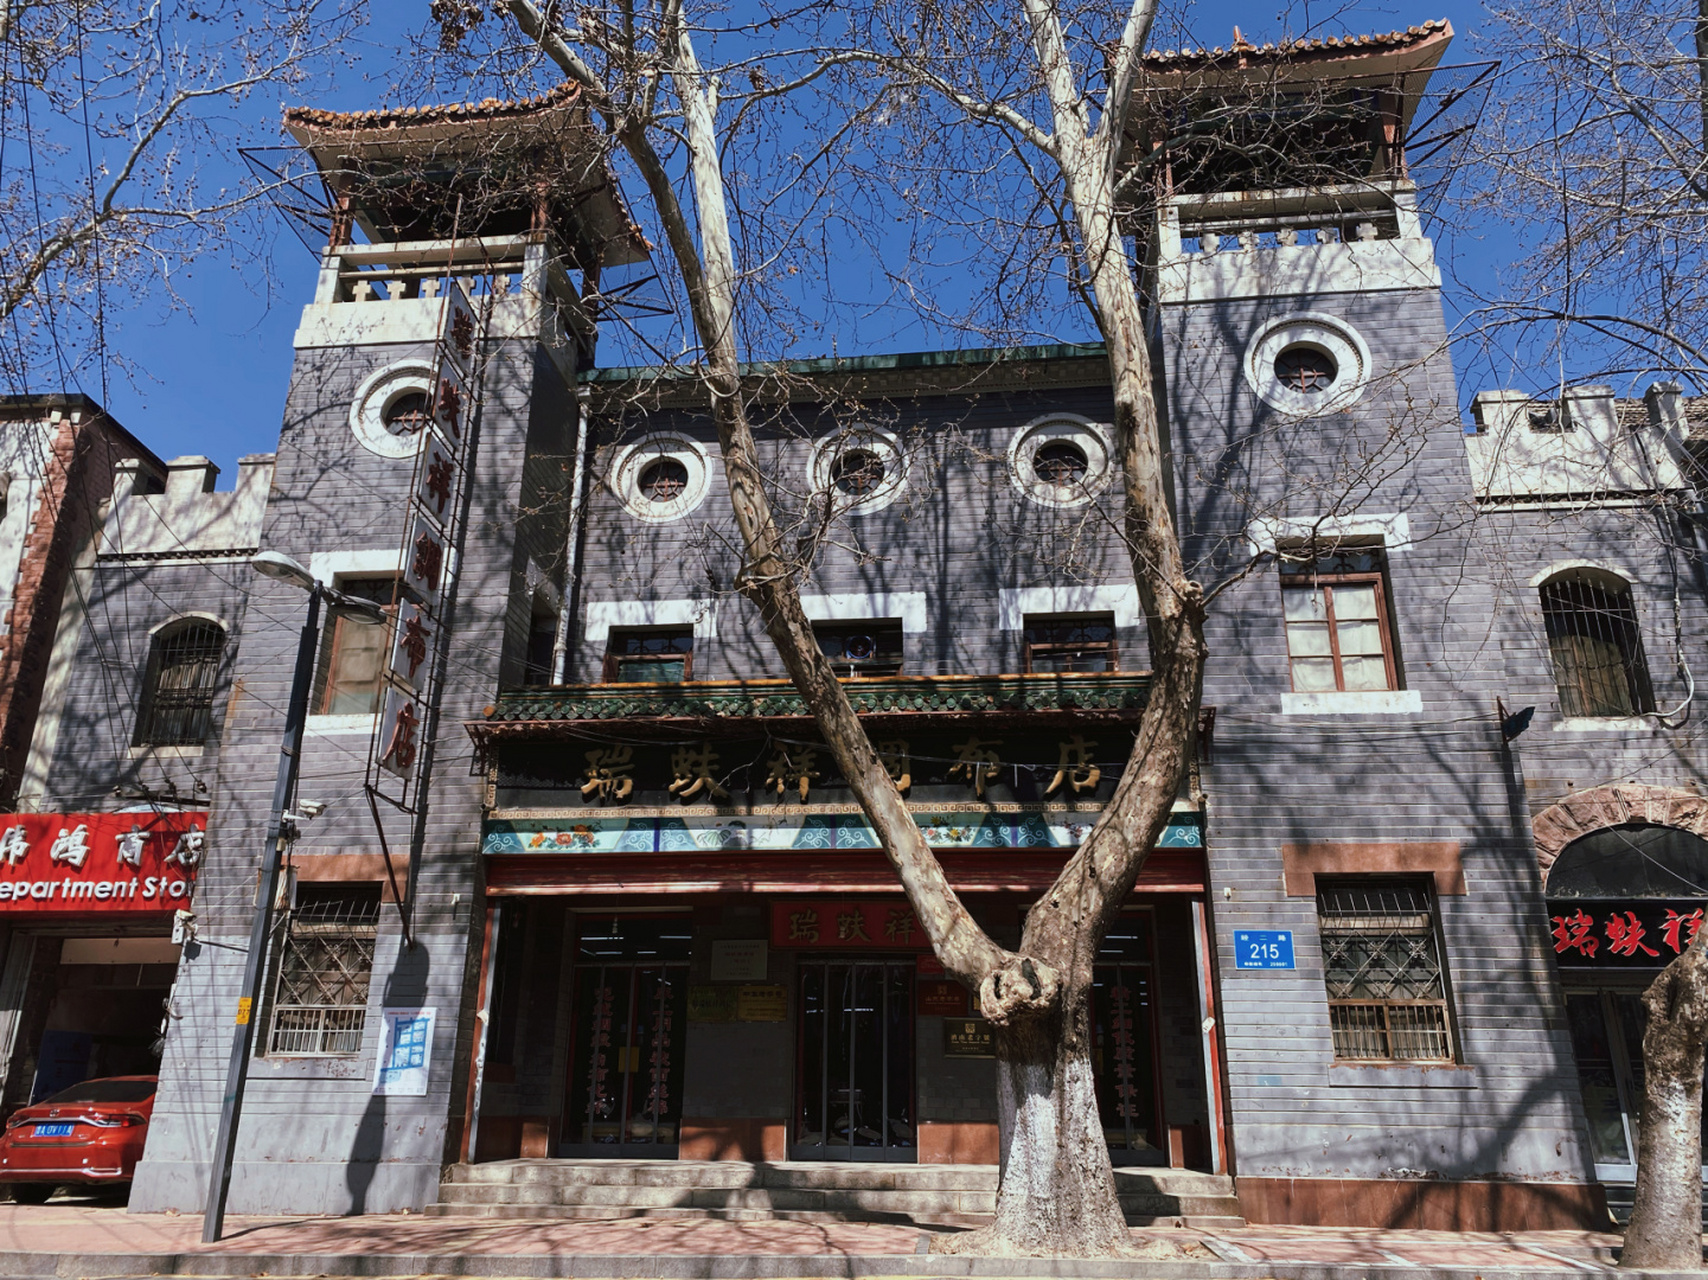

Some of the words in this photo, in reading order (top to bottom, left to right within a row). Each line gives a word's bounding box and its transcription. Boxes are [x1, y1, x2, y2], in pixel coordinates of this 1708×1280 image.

[788, 907, 916, 944] 瑞蚨祥
[1250, 943, 1279, 959] 215
